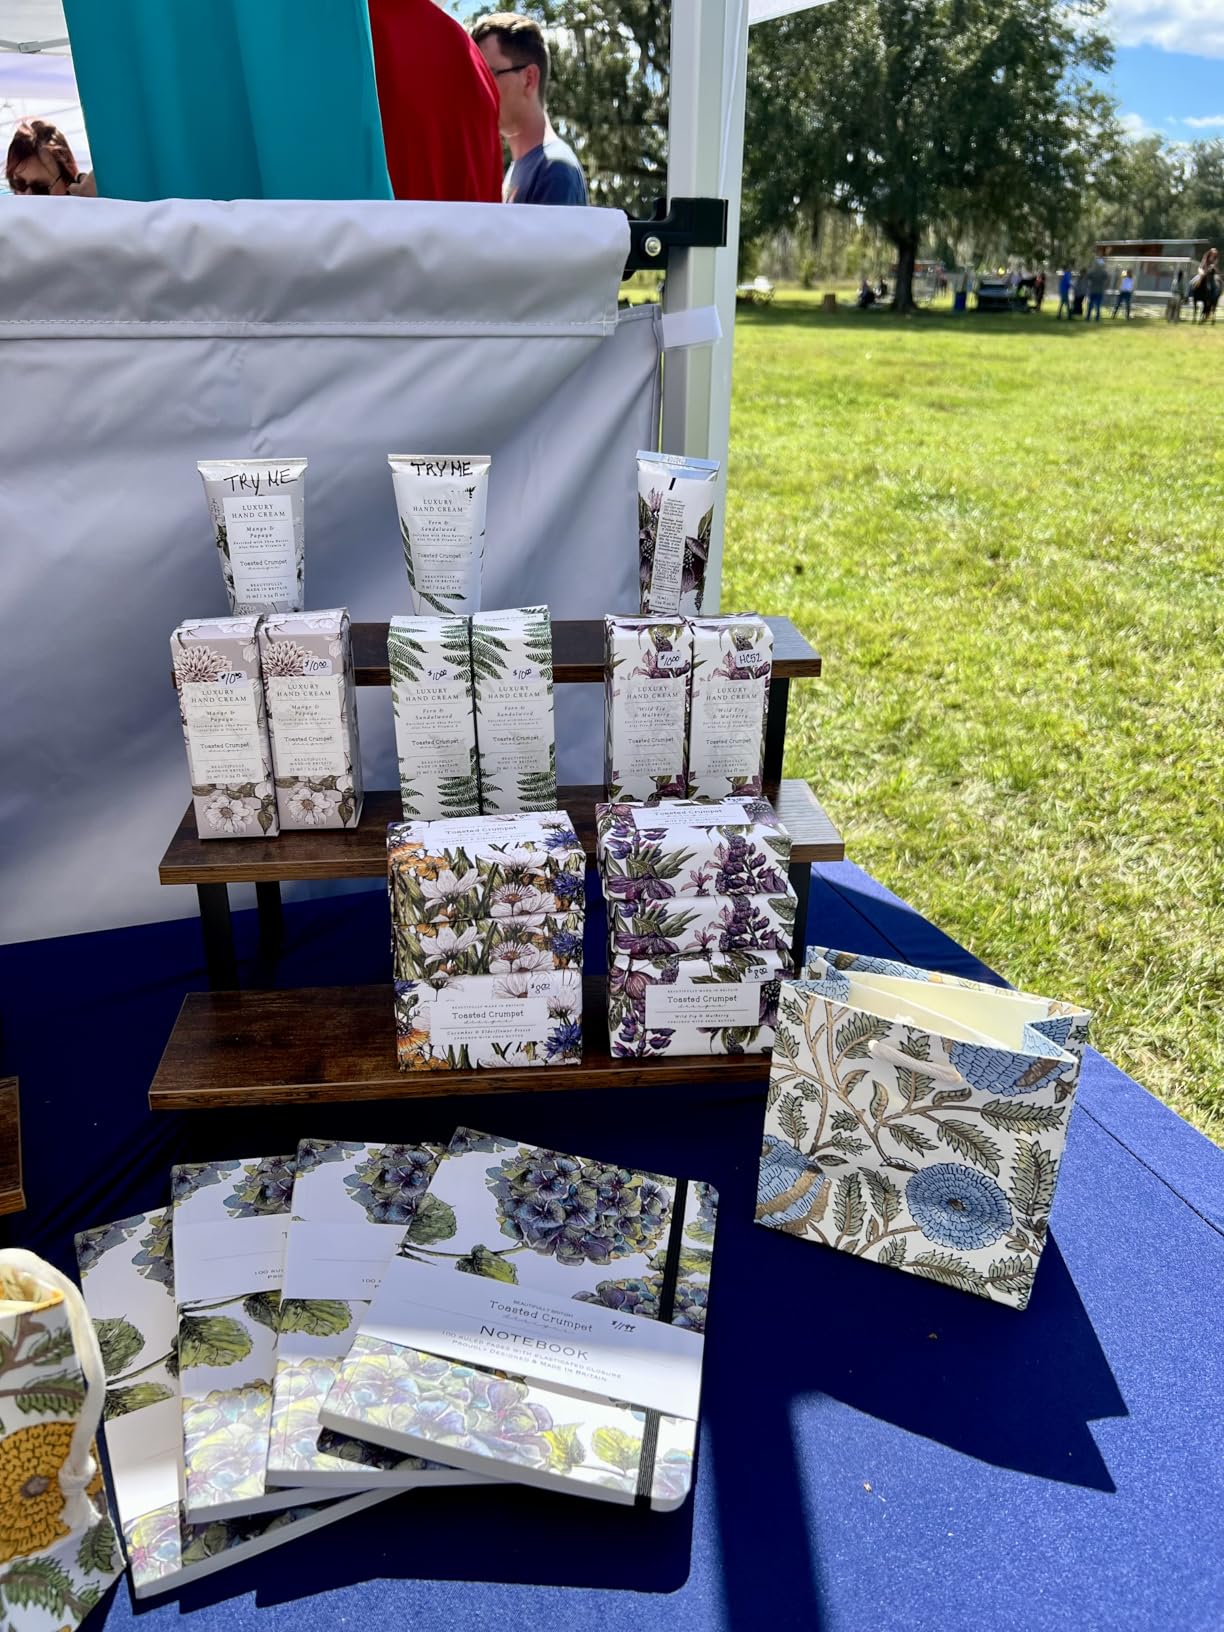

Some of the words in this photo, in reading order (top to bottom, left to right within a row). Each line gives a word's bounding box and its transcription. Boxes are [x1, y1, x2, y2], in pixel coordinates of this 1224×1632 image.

[410, 460, 446, 477] TRY
[451, 460, 472, 477] ME
[224, 473, 259, 496] TRY
[268, 469, 298, 486] ME
[703, 995, 737, 1003] Crumpet
[488, 1010, 524, 1018] Crumpet
[490, 1300, 537, 1319] Toasted
[542, 1311, 592, 1333] Crumpet
[513, 1300, 551, 1313] BEAUTIFULLY
[480, 1325, 589, 1360] NOTEBOOK
[452, 1340, 487, 1352] PROUDLY
[489, 1348, 530, 1363] DESIGNED
[540, 1361, 561, 1371] MADE
[575, 1370, 607, 1382] BRITAIN
[461, 1334, 484, 1344] RULED
[486, 1340, 510, 1351] PAGES
[513, 1347, 532, 1357] WITH
[534, 1353, 585, 1370] ELASTICATED
[586, 1365, 622, 1379] CLOSURE
